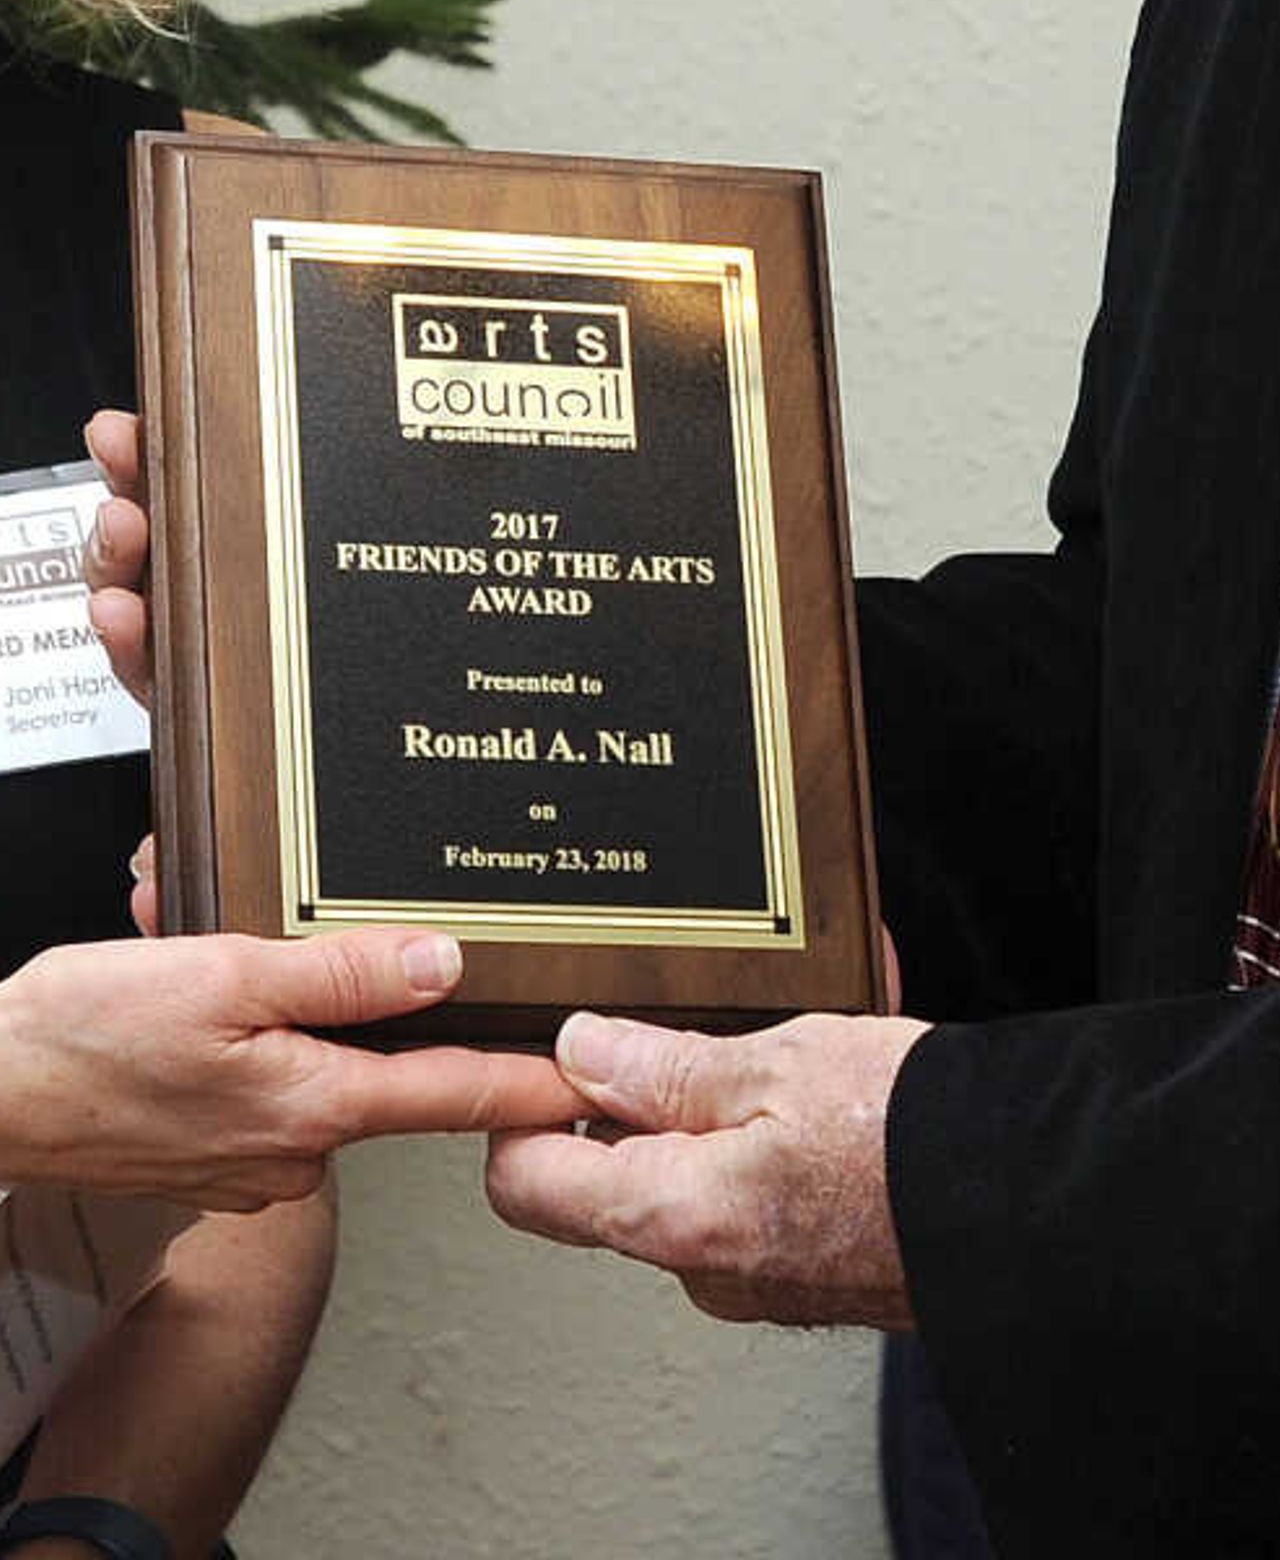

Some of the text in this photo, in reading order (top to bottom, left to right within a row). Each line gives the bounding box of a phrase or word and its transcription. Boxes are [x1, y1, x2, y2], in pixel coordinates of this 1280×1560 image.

[419, 313, 608, 363] arts
[412, 373, 623, 420] council
[401, 424, 424, 440] of
[490, 512, 559, 540] 2017
[336, 543, 716, 584] FRIENDS OF THE ARTS
[467, 586, 593, 616] AWARD
[32, 626, 97, 654] MEM
[62, 671, 118, 698] Han
[467, 669, 603, 695] Presented to
[402, 724, 674, 766] Ronald A. Nall
[528, 803, 557, 821] on
[444, 845, 648, 874] February 23, 2018
